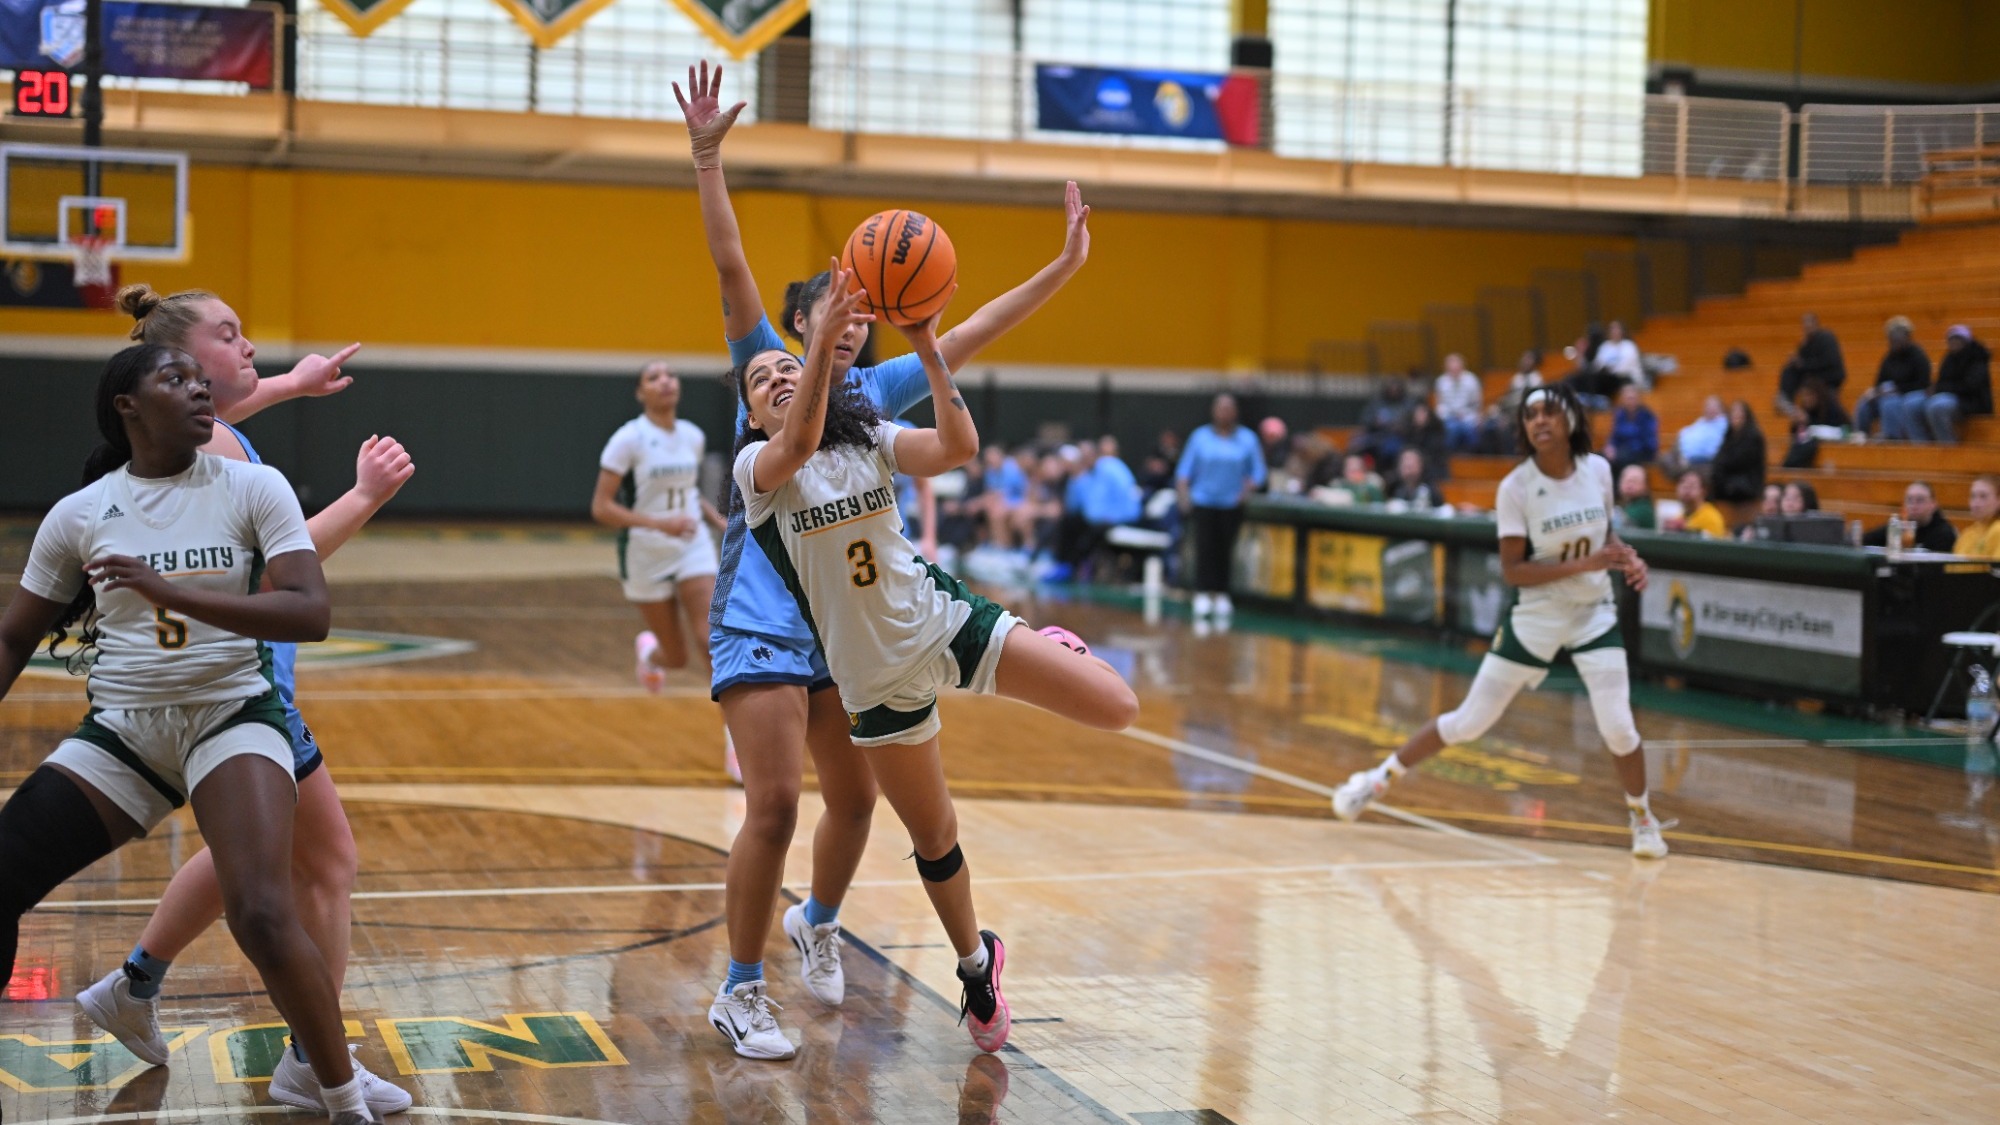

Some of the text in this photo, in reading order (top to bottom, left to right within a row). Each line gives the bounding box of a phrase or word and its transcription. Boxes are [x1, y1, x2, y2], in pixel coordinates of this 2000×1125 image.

[17, 70, 69, 114] 20
[891, 211, 926, 265] Wilson
[102, 511, 125, 521] adidas
[791, 495, 862, 533] JERSEY
[185, 546, 234, 569] CITY
[846, 538, 879, 588] 3
[155, 606, 188, 650] 5
